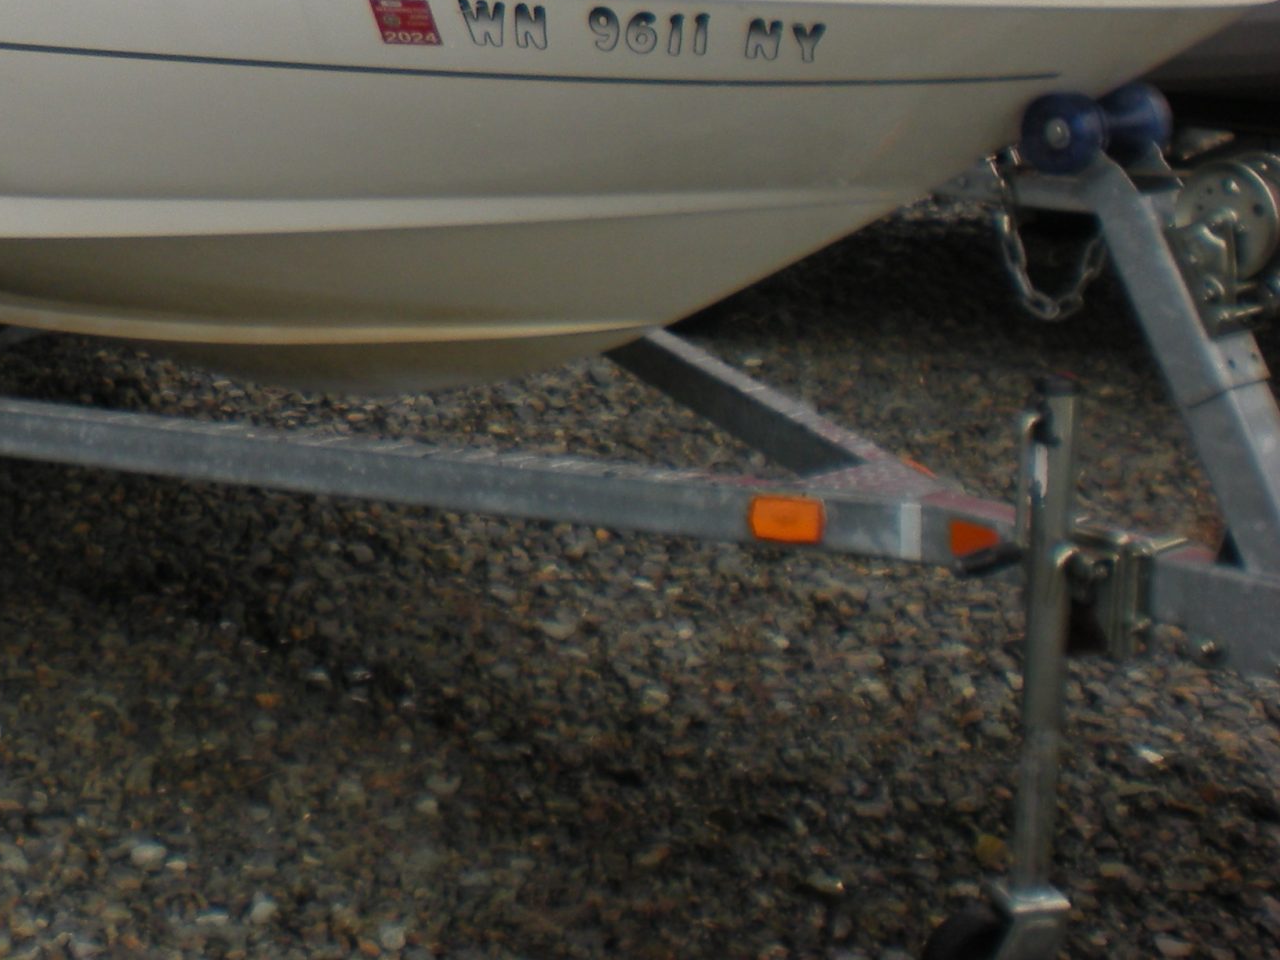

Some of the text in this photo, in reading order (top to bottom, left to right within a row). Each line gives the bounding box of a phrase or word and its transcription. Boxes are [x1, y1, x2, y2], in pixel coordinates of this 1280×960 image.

[384, 31, 438, 44] 2024
[588, 6, 711, 56] 9611
[744, 17, 827, 64] NY
